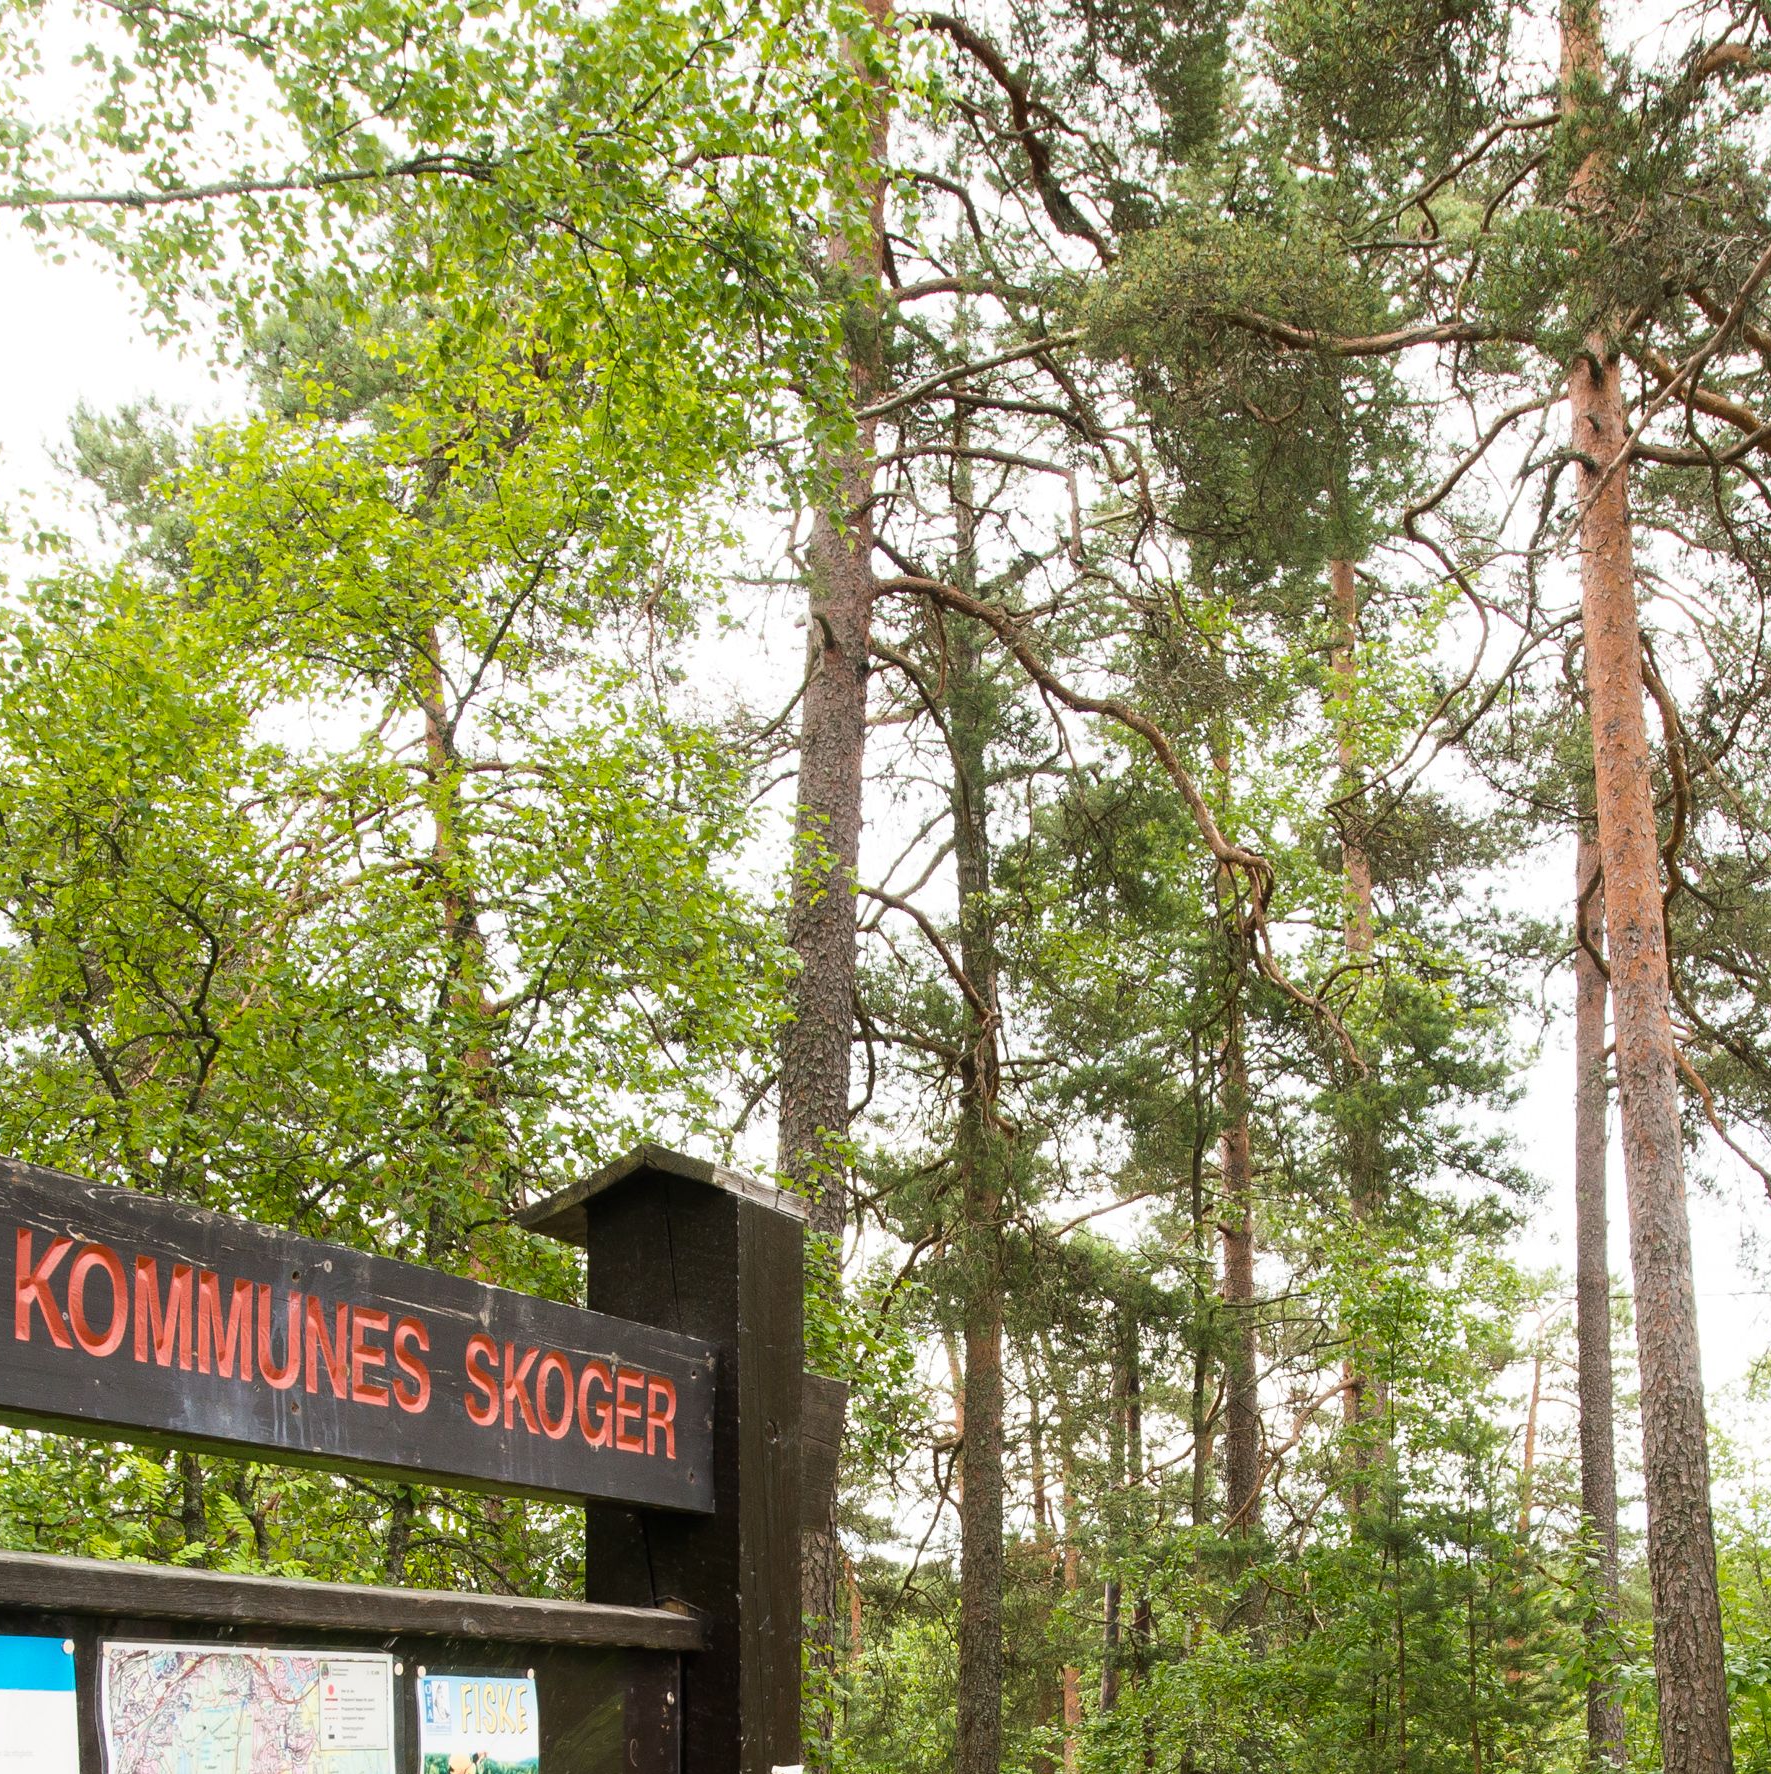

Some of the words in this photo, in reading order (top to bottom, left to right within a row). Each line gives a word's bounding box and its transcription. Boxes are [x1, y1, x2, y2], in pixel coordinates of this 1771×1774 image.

[14, 1226, 431, 1414] KOMMUNES
[465, 1332, 676, 1460] SKOGER
[460, 1683, 528, 1734] FISKE
